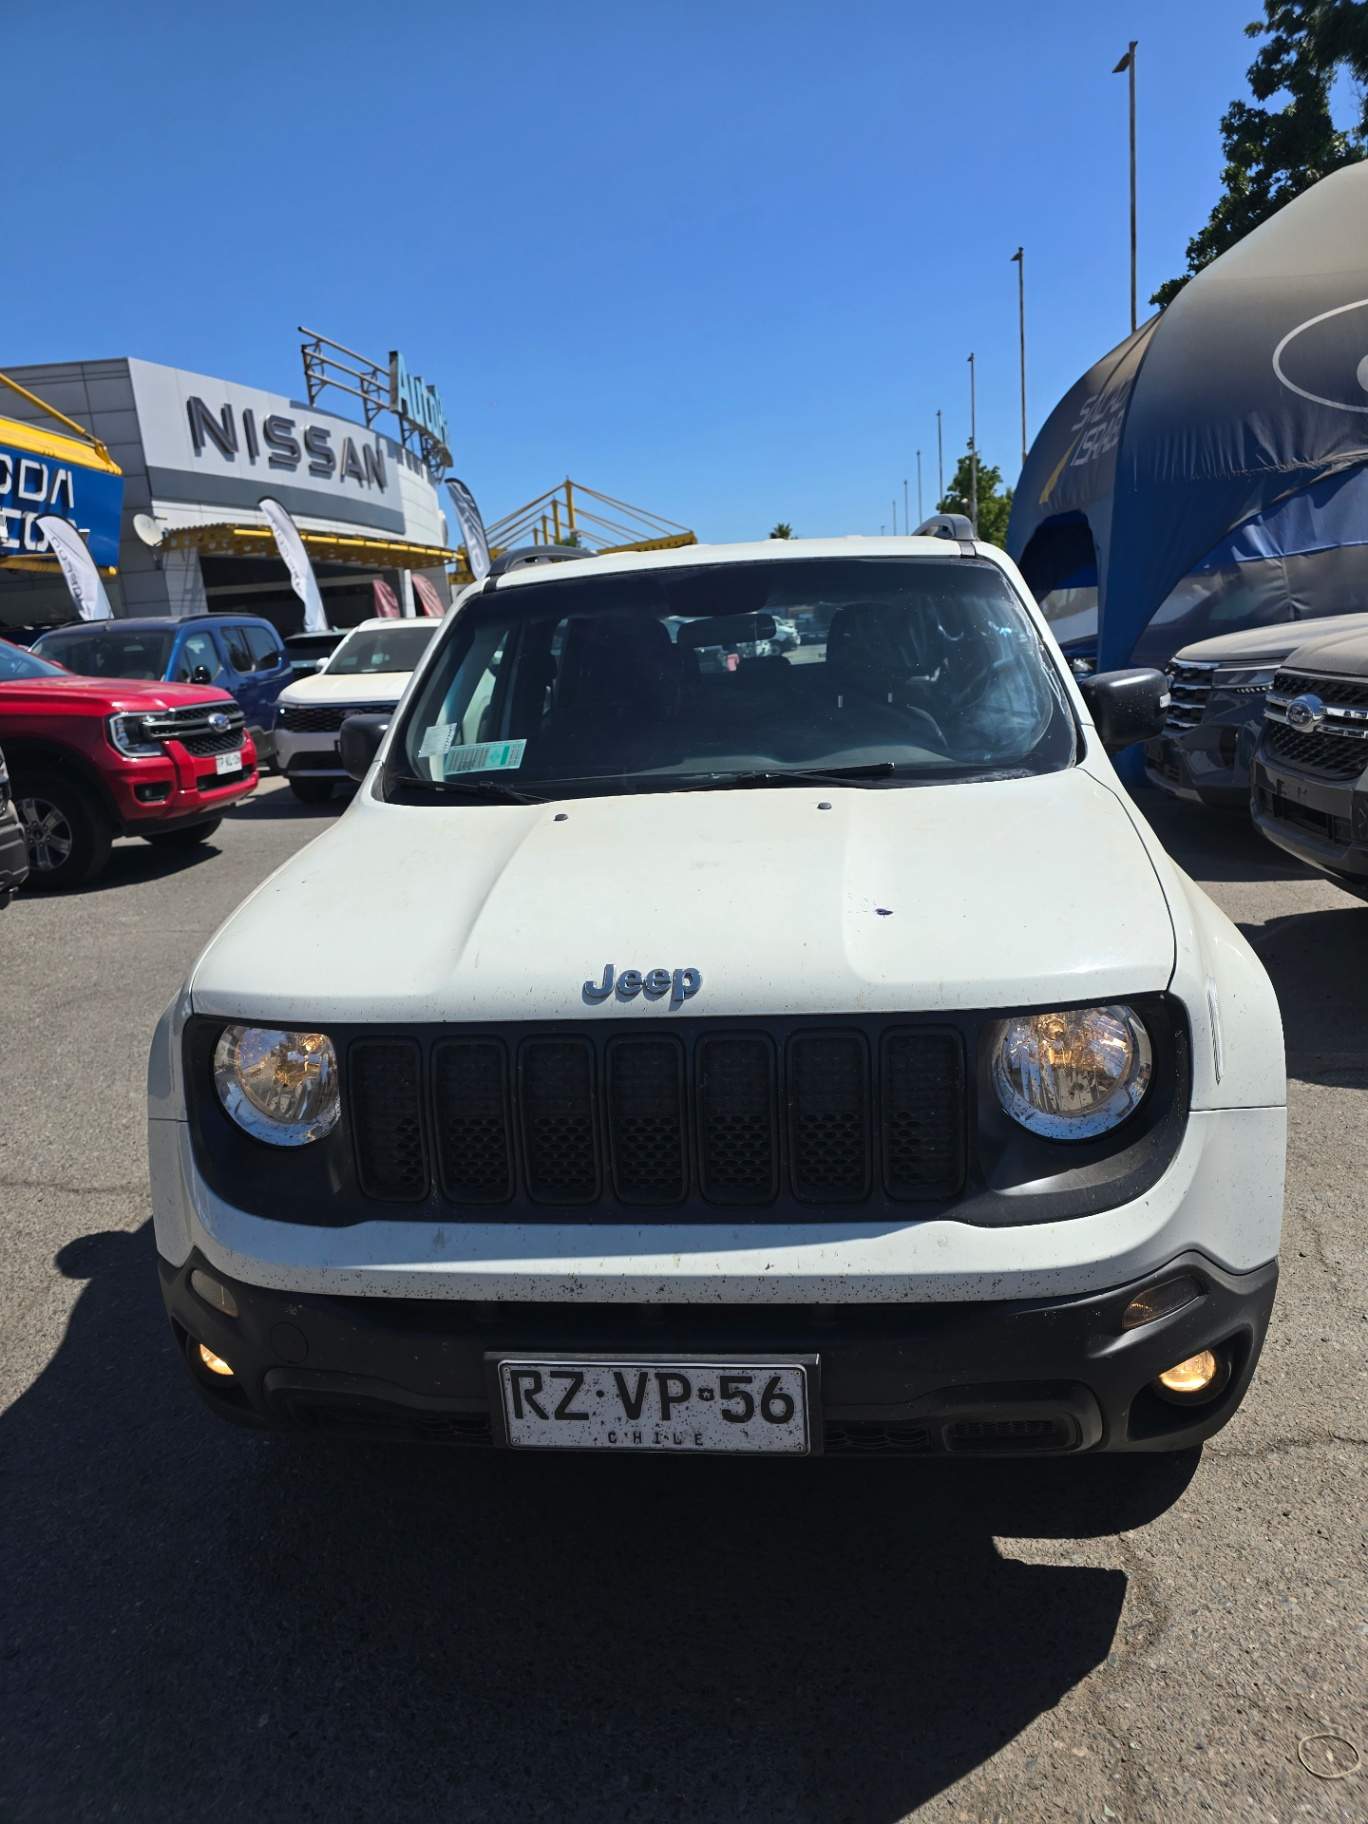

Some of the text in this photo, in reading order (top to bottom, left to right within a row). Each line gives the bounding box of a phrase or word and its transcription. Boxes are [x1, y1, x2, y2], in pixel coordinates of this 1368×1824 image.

[187, 396, 388, 491] NISSAN
[582, 963, 704, 1006] Jeep
[607, 1430, 705, 1447] CHILE
